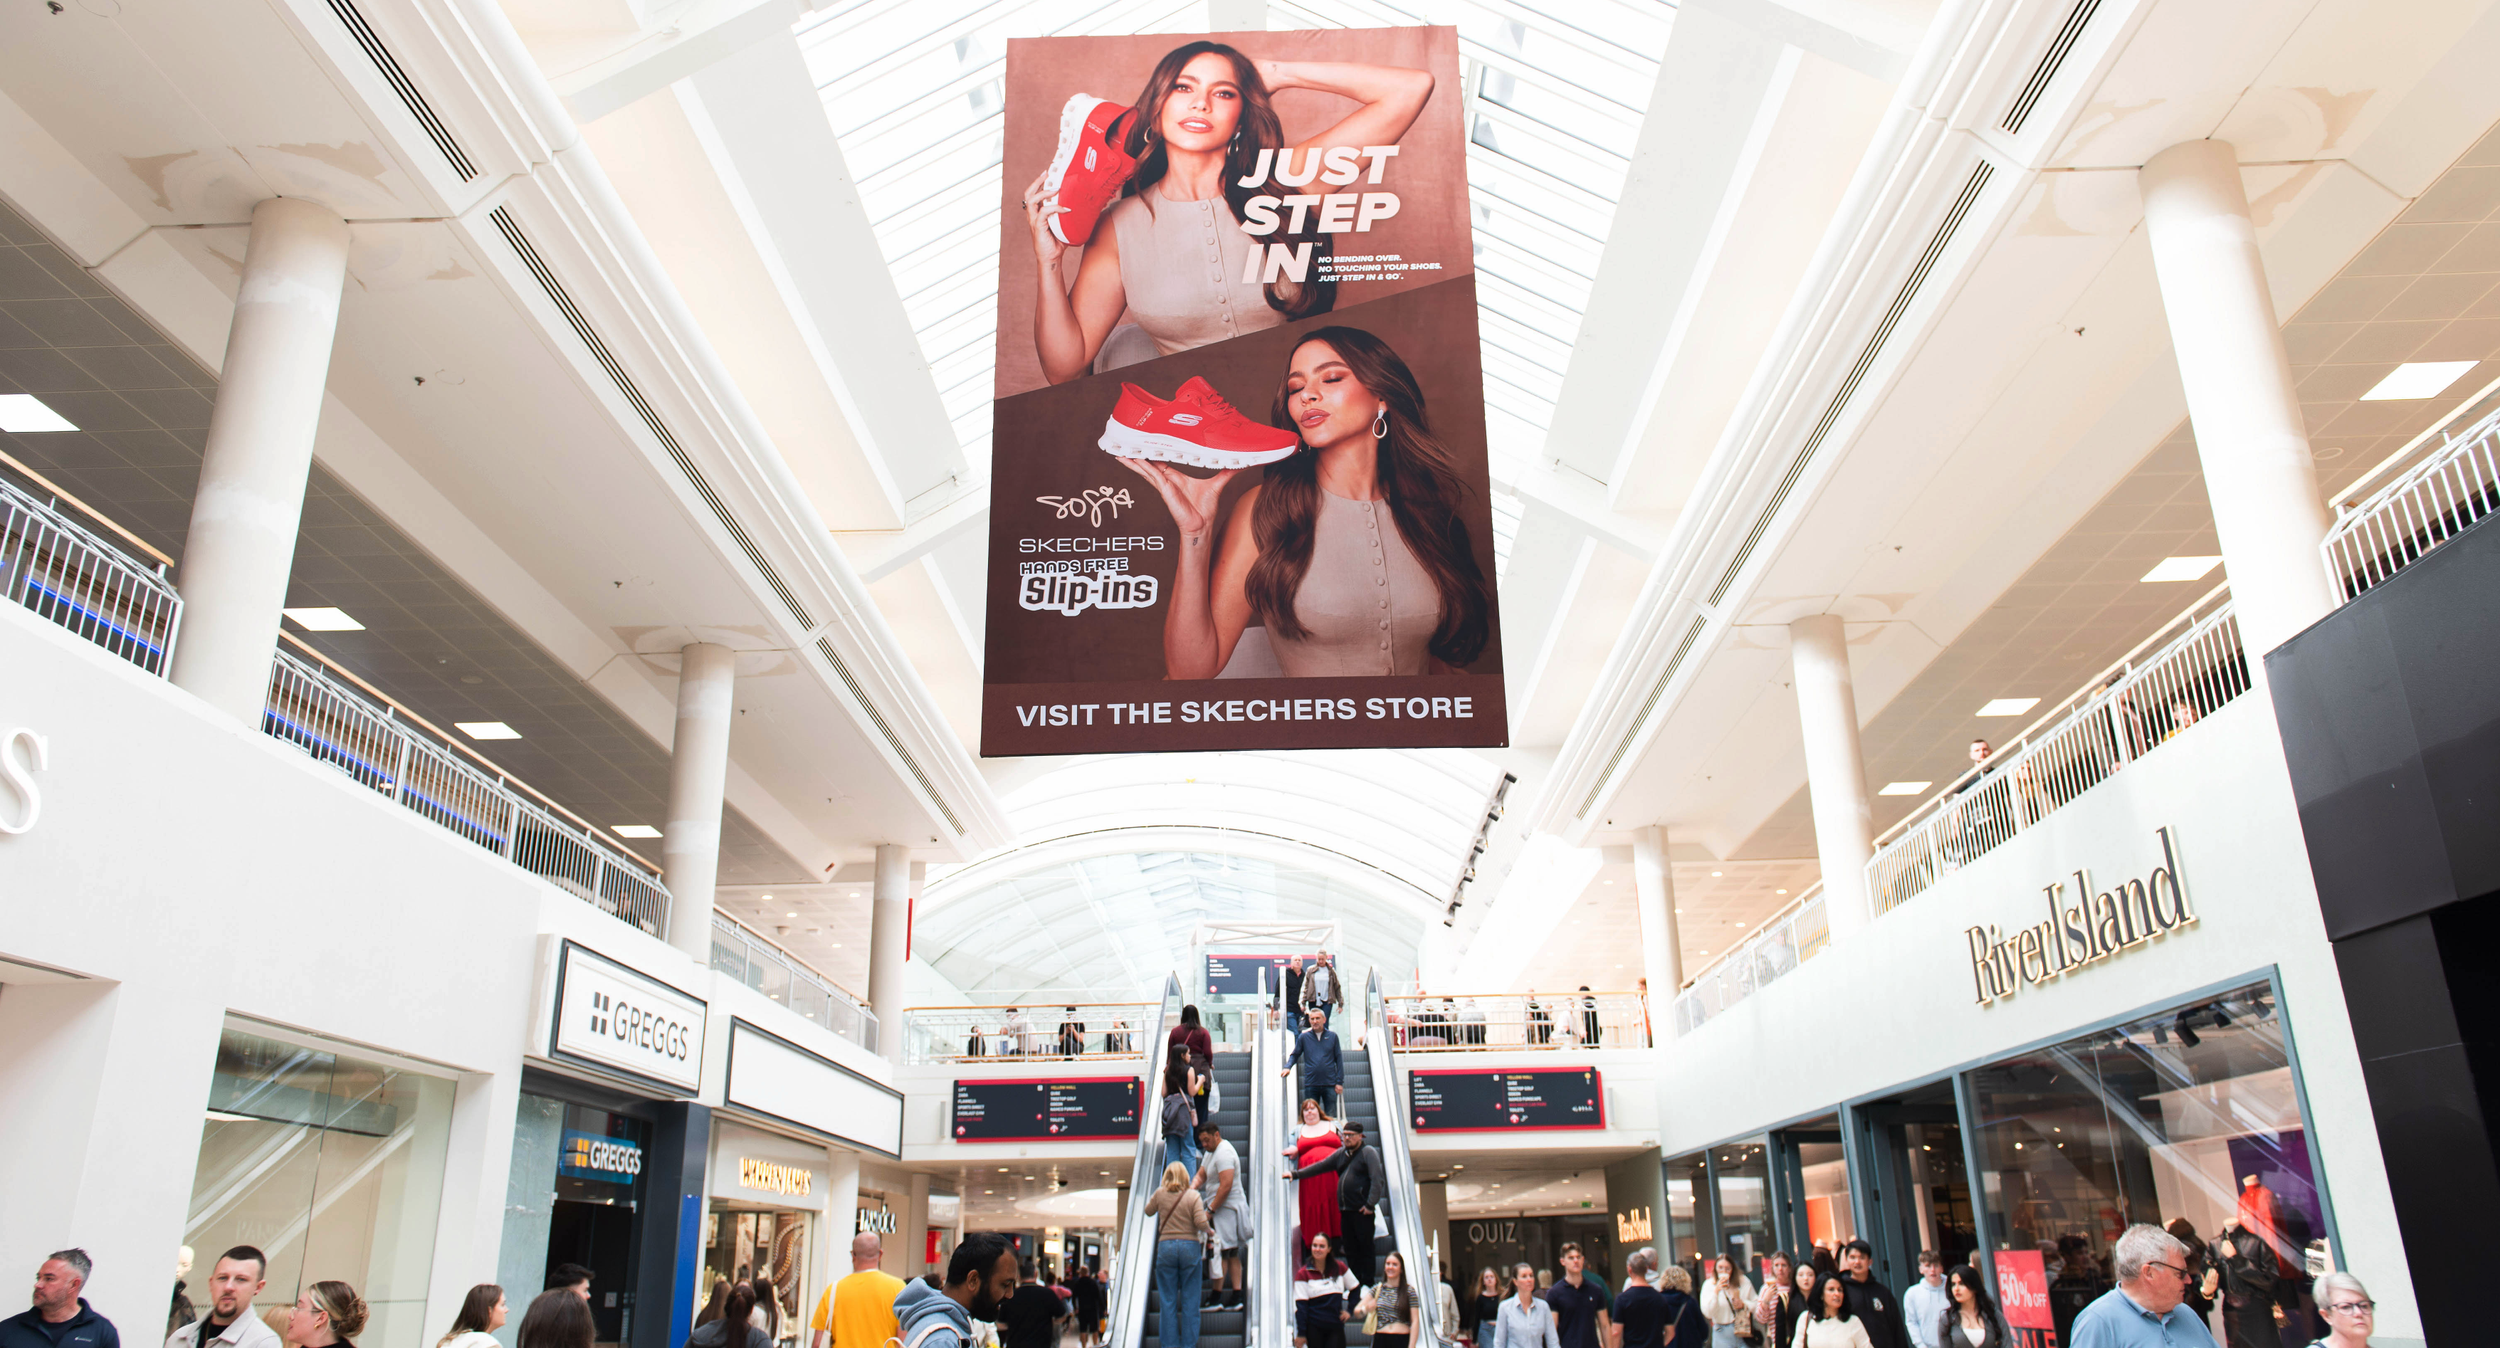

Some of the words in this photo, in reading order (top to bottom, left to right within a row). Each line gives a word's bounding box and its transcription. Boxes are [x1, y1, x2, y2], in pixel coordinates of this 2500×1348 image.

[1237, 145, 1400, 188] JUST
[1239, 192, 1401, 236] STEP
[1333, 255, 1374, 263] BENDING
[1375, 254, 1402, 262] OVER.
[1334, 264, 1382, 272] TOUCHING
[1383, 263, 1409, 271] YOUR
[1410, 262, 1442, 270] SHOES.
[1342, 274, 1365, 282] STEP
[1366, 273, 1376, 281] IN
[1019, 536, 1165, 553] SKECHERS
[1020, 560, 1081, 575] HANDS
[1084, 557, 1128, 572] FREE
[1023, 573, 1155, 612] Slip-ins
[1016, 704, 1099, 727] VISIT
[1107, 702, 1172, 724] THE
[1180, 699, 1356, 723] SKECHERS
[1365, 697, 1474, 720] STORE
[614, 1001, 688, 1062] GREGGS
[590, 1141, 642, 1175] GREGGS
[739, 1157, 782, 1193] WARREN
[780, 1166, 812, 1198] JAMES
[1468, 1221, 1517, 1245] QUIZ
[2000, 1272, 2033, 1308] 50%
[2033, 1292, 2047, 1308] OFF
